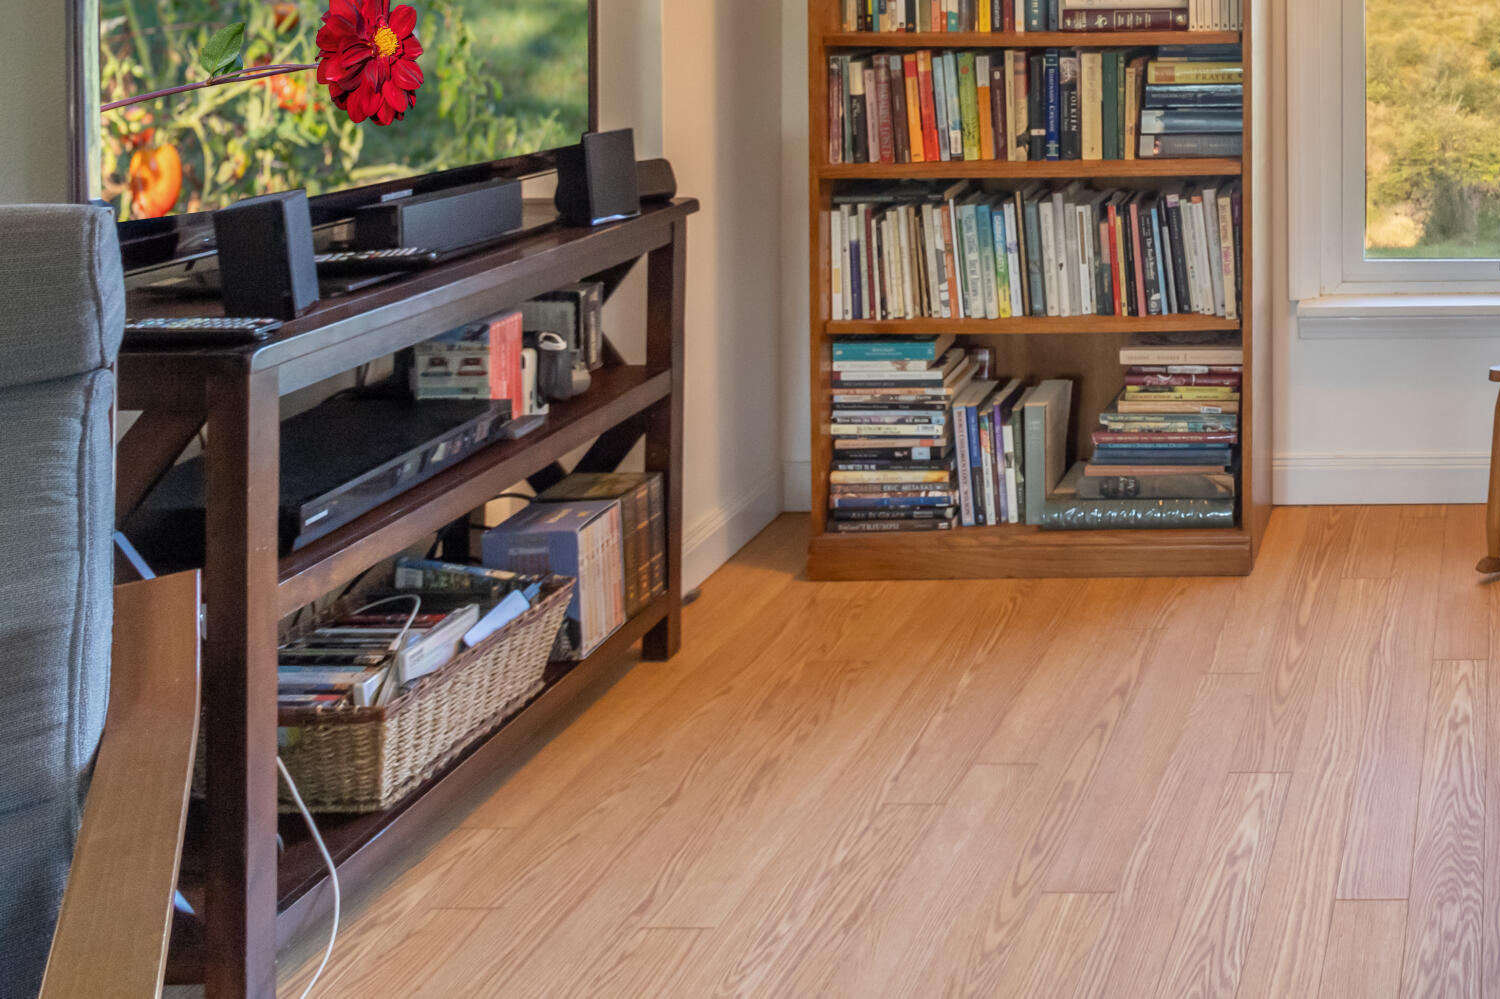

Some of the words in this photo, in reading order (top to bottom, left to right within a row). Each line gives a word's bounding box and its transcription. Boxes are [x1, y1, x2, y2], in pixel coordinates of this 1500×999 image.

[1194, 72, 1235, 81] PRAYER
[879, 82, 890, 123] PARADISE
[1070, 90, 1078, 132] TOLKIEN
[880, 127, 892, 151] LOST
[1146, 238, 1154, 248] The
